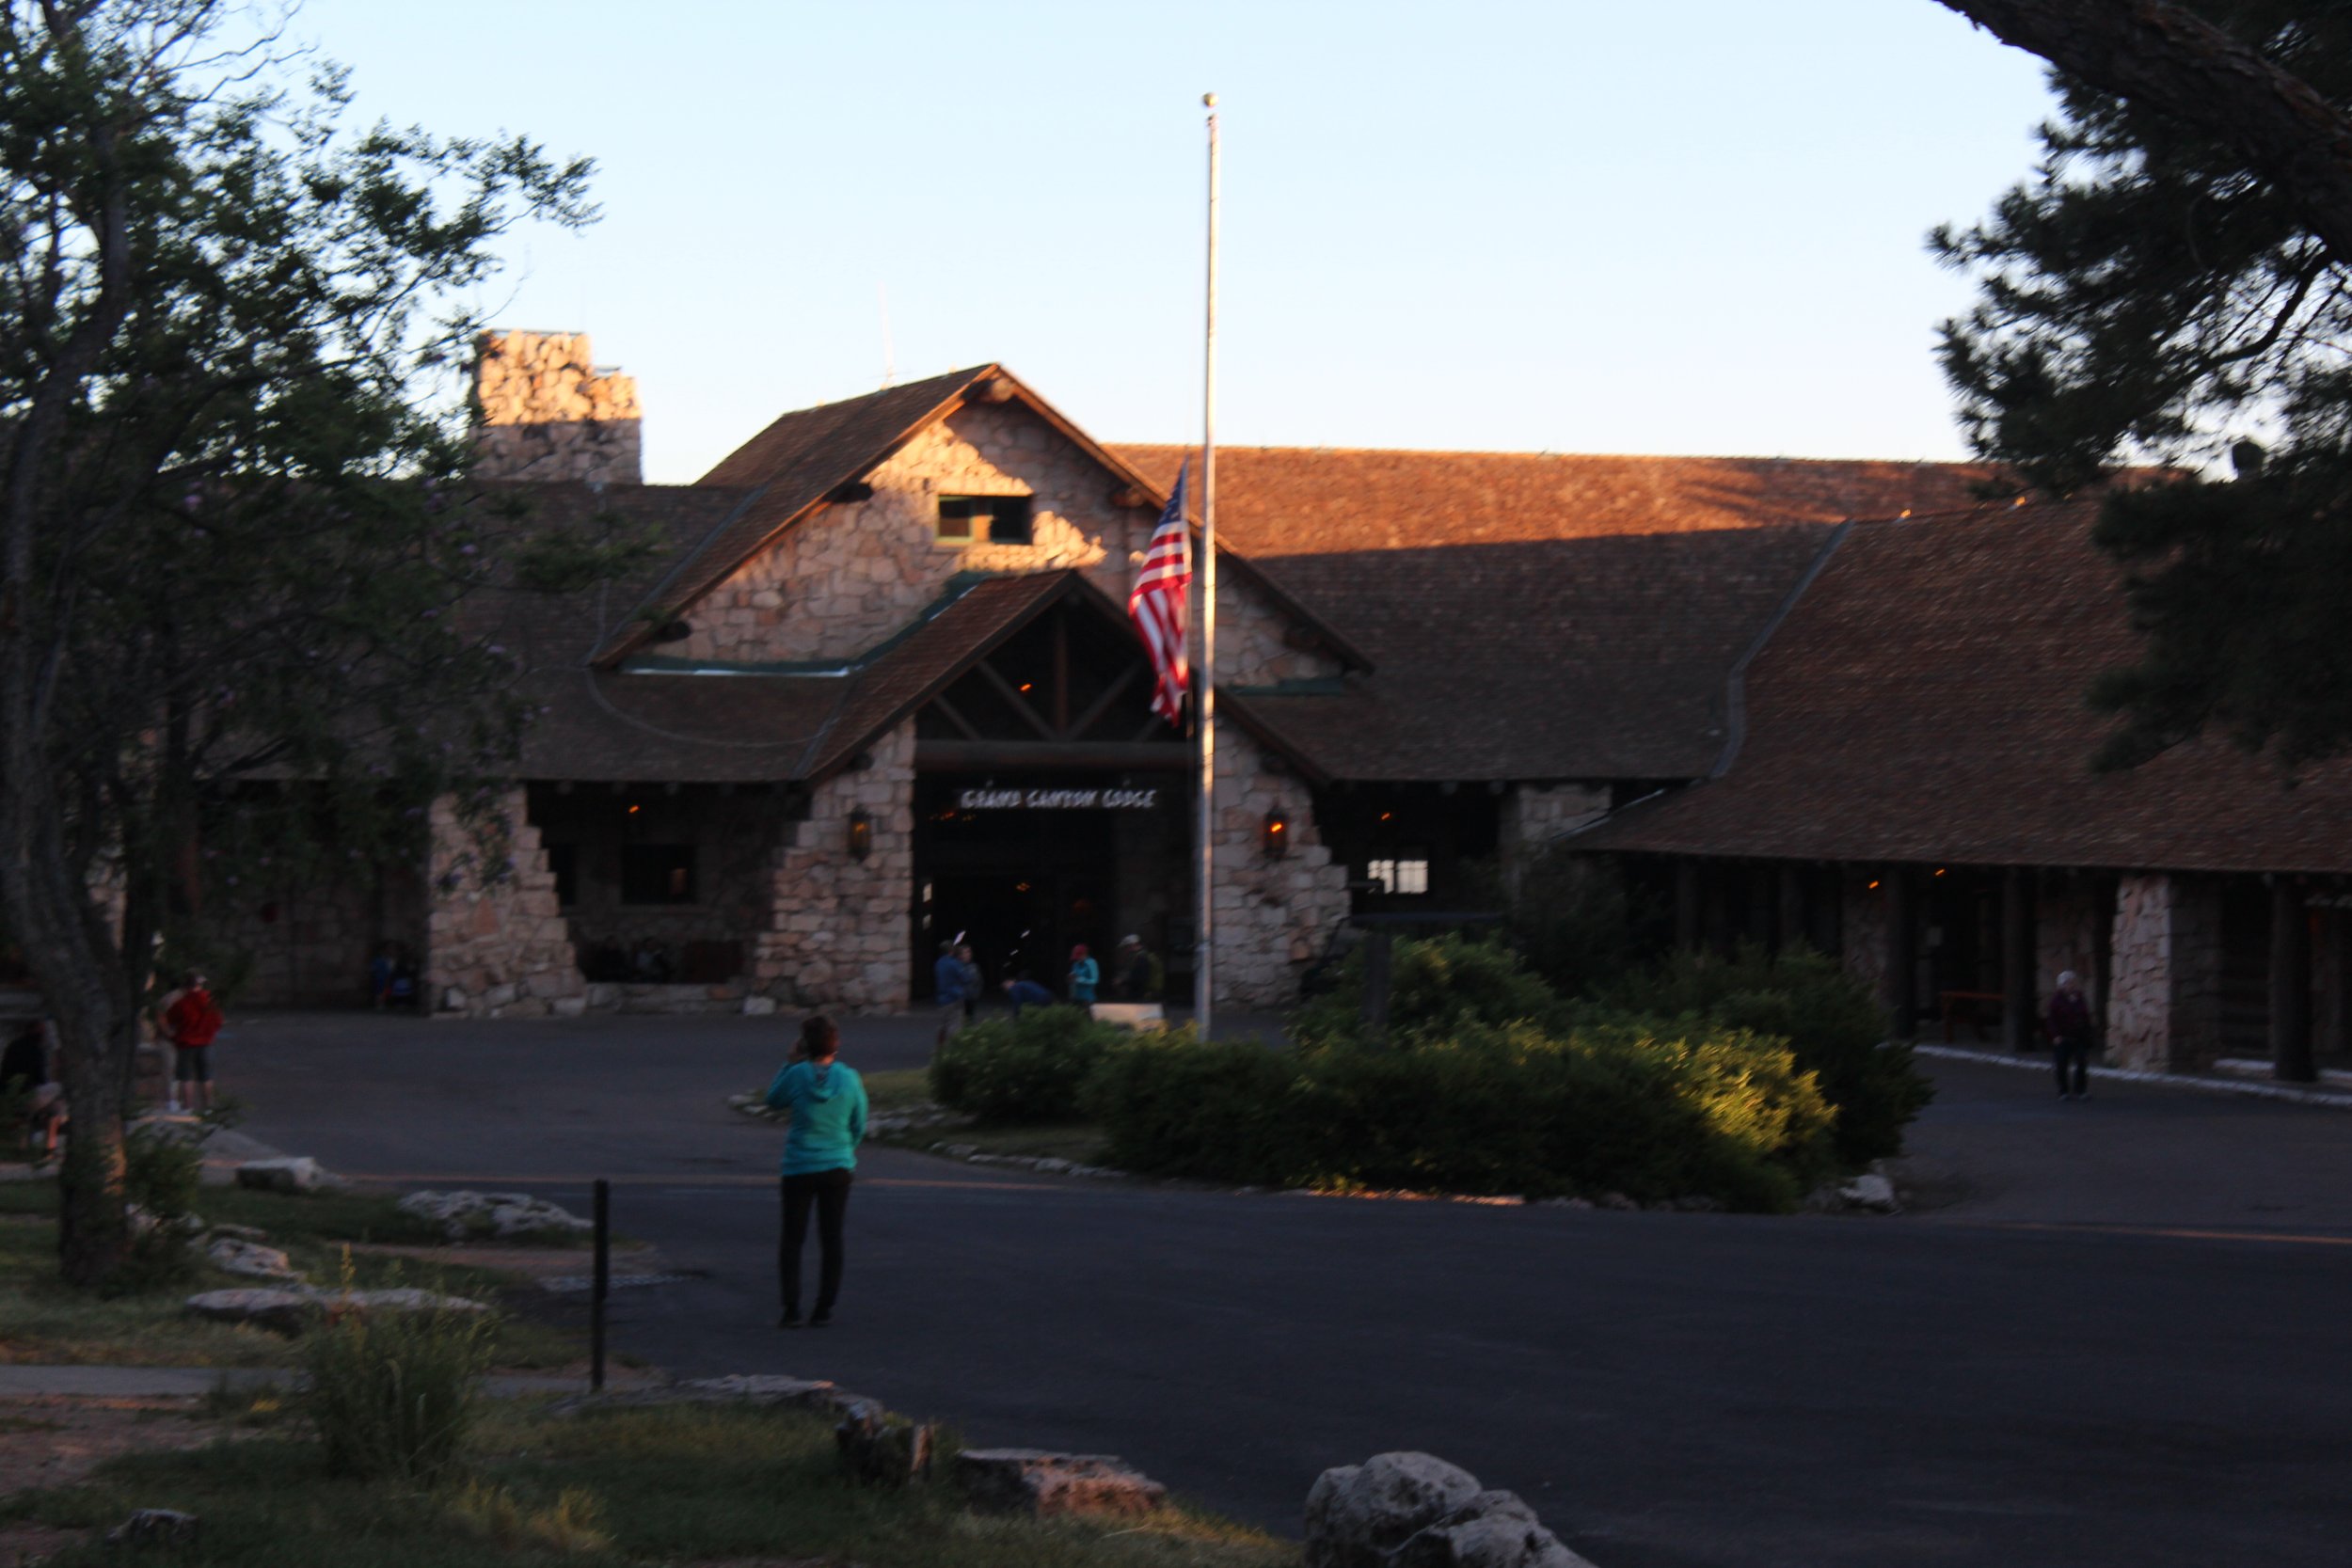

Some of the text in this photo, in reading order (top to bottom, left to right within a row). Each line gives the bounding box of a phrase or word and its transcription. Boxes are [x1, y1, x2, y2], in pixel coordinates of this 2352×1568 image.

[961, 788, 1157, 809] GRAND CANYON LODGE
